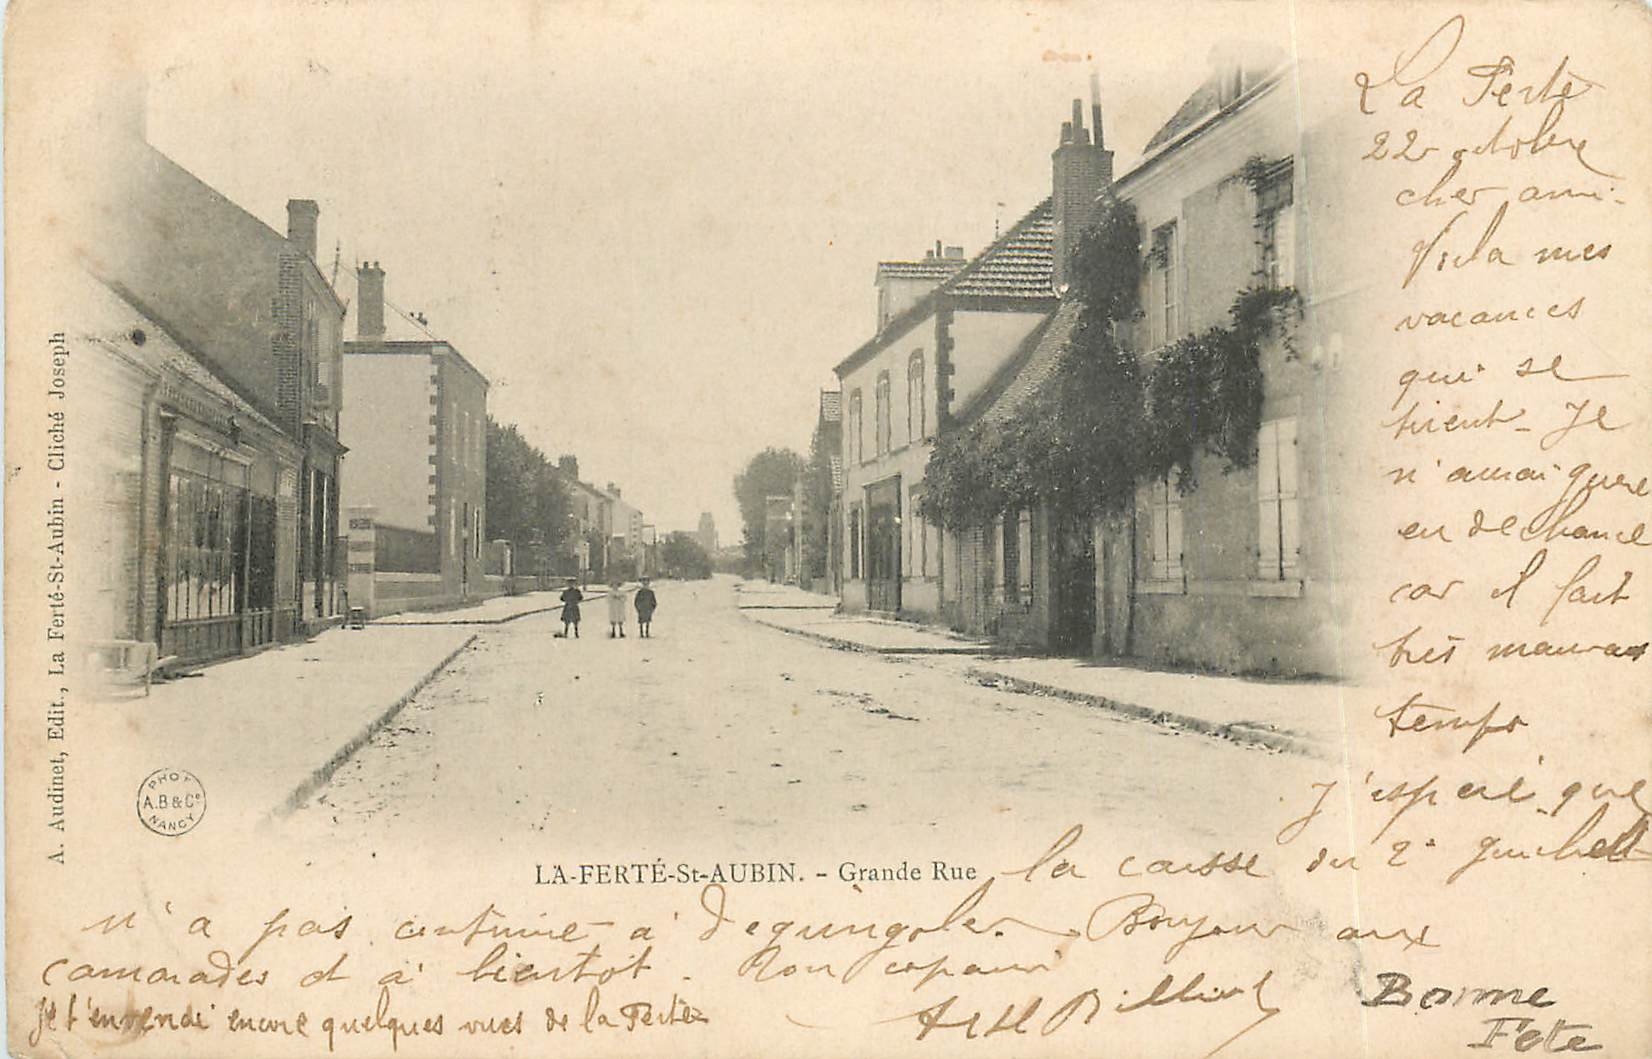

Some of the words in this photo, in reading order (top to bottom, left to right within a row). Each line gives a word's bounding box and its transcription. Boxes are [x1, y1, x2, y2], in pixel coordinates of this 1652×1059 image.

[1394, 297, 1586, 332] vacances
[1392, 363, 1486, 411] qui
[1468, 509, 1518, 537] de
[1374, 692, 1528, 753] temps
[1000, 824, 1086, 882] la
[240, 907, 353, 961] pas
[1361, 972, 1556, 1009] Bonne
[322, 986, 444, 1052] quelques
